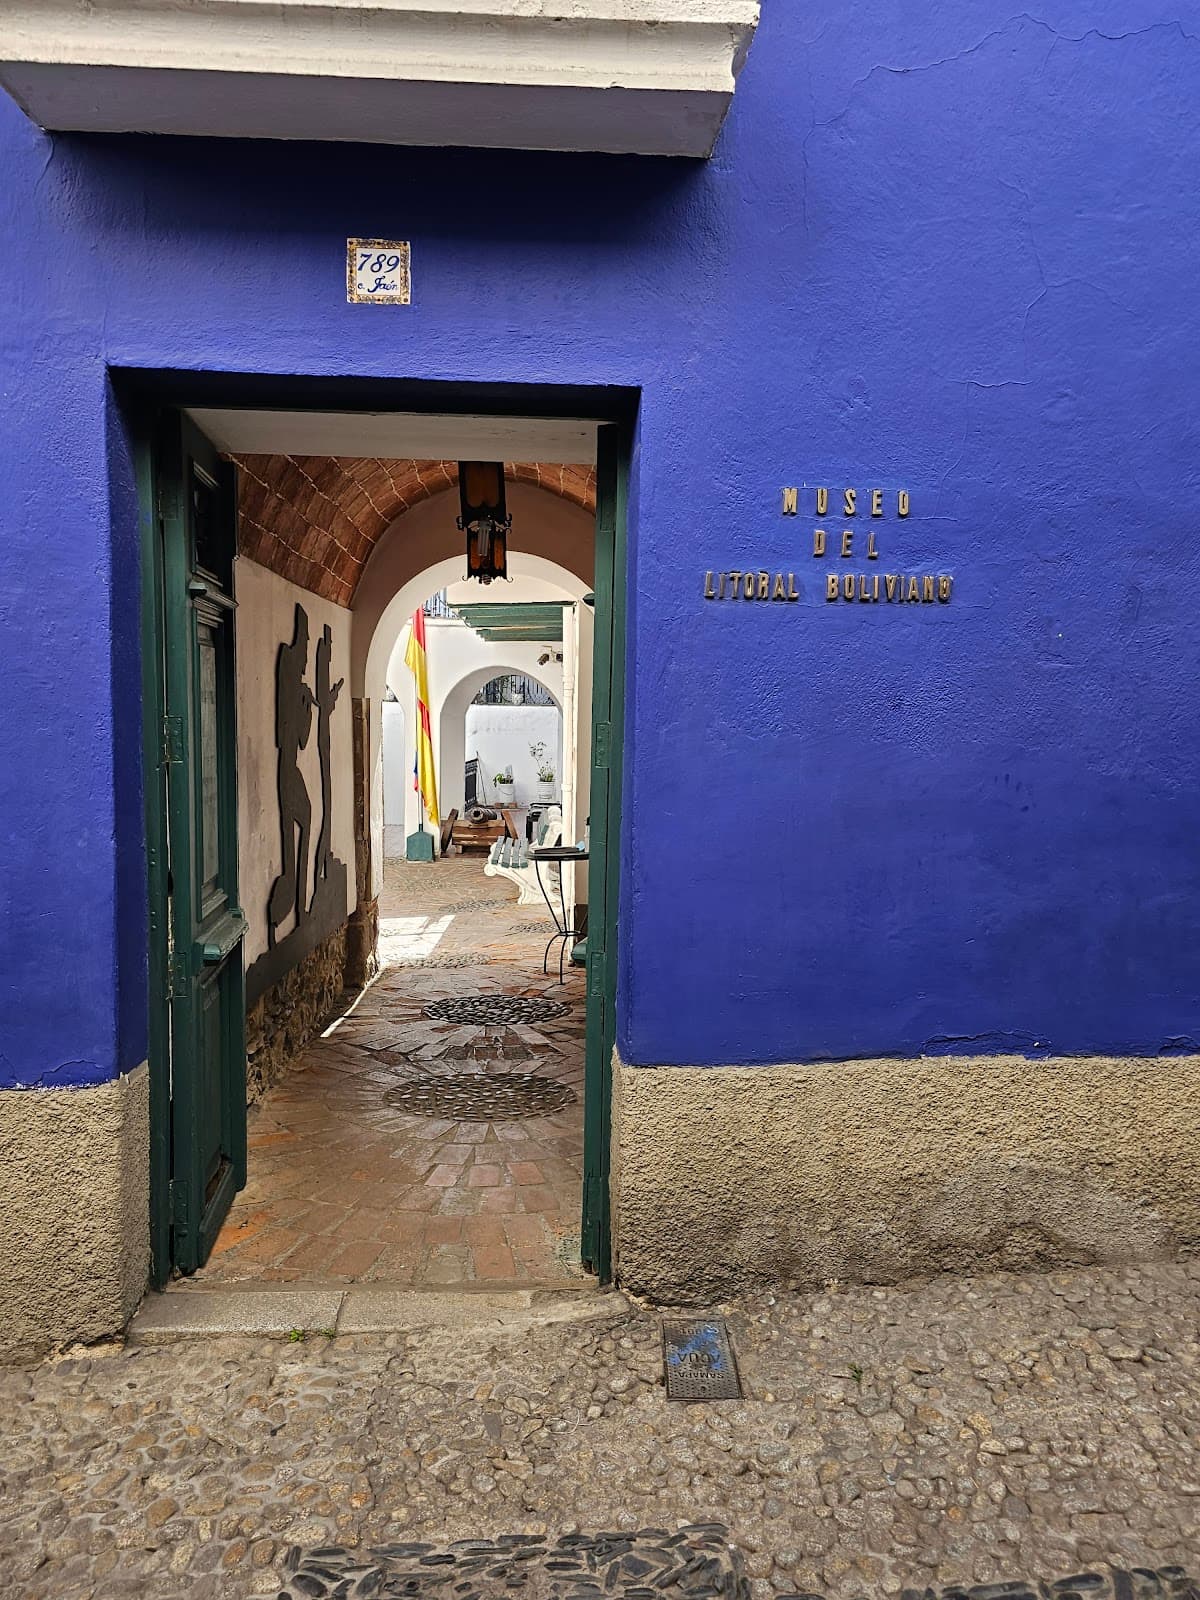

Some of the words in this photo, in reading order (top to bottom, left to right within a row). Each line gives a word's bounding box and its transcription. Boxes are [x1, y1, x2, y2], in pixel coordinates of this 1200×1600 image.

[358, 253, 400, 273] 789
[782, 487, 910, 516] MUSEO
[812, 529, 879, 559] DEL
[703, 570, 800, 600] LITORAL
[825, 572, 952, 603] BOLIVIANO
